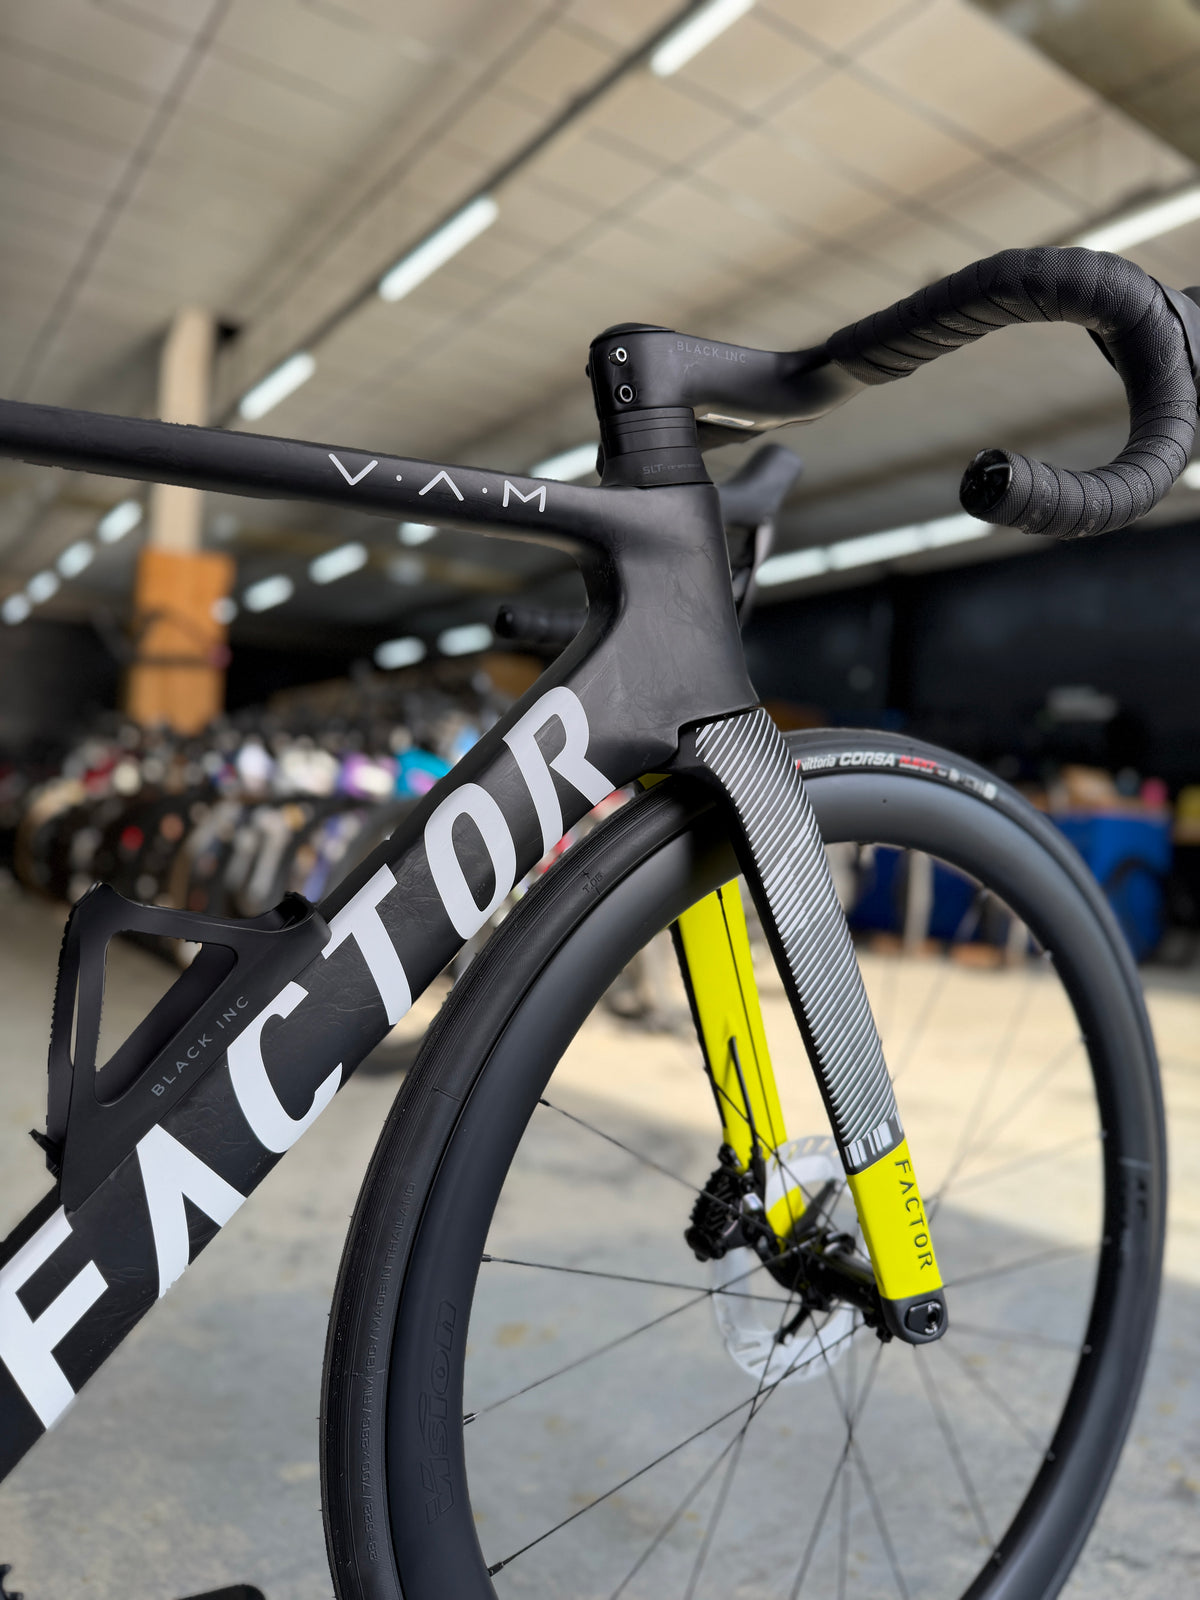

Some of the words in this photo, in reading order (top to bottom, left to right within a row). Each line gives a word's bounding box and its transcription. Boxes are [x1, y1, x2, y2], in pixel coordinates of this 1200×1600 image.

[676, 341, 719, 358] BLACK
[725, 350, 746, 363] INC
[642, 463, 663, 475] SLT
[801, 754, 837, 771] vittoria
[839, 751, 895, 767] CORSA
[0, 686, 616, 1431] FACTOR
[151, 1033, 213, 1096] BLACK
[216, 996, 248, 1028] INC
[384, 1182, 417, 1262] THAILAND
[895, 1158, 933, 1270] FACTOR
[381, 1265, 393, 1280] IN
[372, 1284, 387, 1331] MADE
